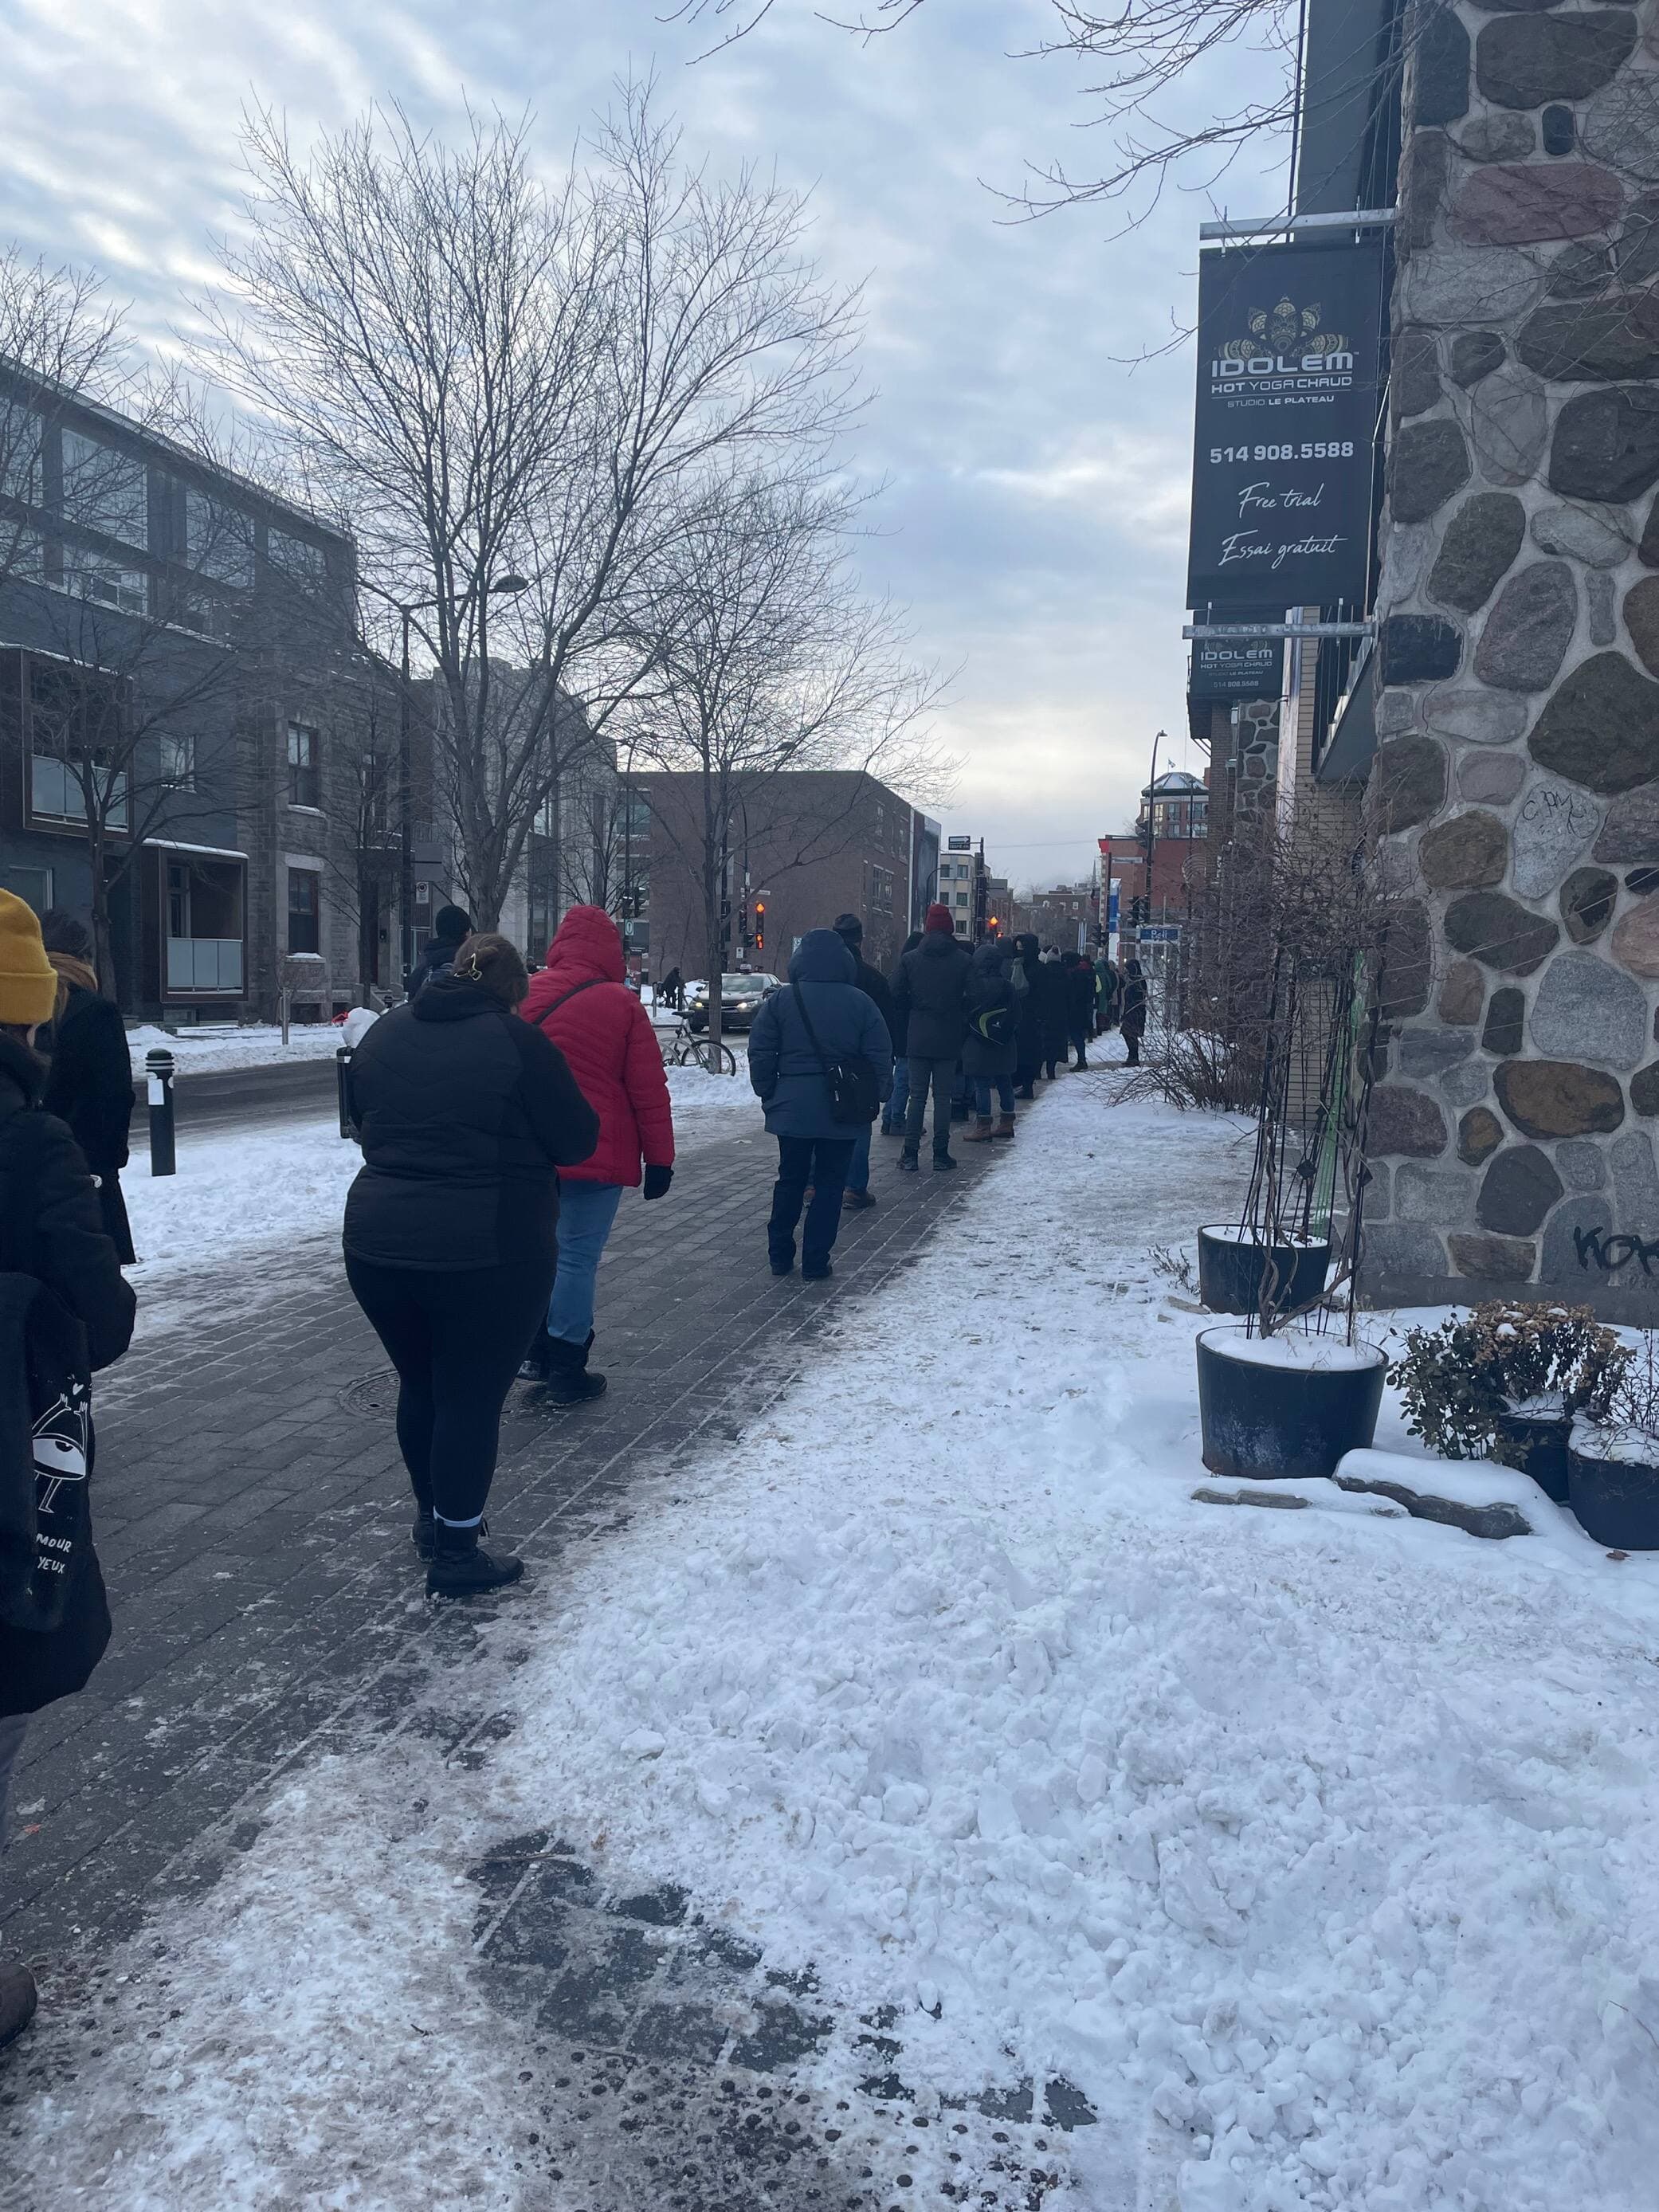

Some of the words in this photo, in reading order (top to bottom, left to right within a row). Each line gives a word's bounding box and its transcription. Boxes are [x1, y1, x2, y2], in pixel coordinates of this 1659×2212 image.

[1211, 352, 1354, 378] IDOLEM
[1211, 382, 1245, 394] HOT
[1249, 380, 1294, 391] YOGA
[1296, 376, 1353, 389] CHAUD
[1227, 398, 1265, 408] STUDIO
[1284, 395, 1335, 404] PLATEAU
[1210, 446, 1249, 464] 514
[1253, 441, 1354, 461] 908.5588
[1238, 481, 1277, 519] Free
[1279, 482, 1325, 508] trial
[1218, 529, 1273, 566] Essai
[1271, 534, 1348, 569] gratuit
[1200, 649, 1273, 661] IDOLEM
[37, 1555, 65, 1574] YEUX
